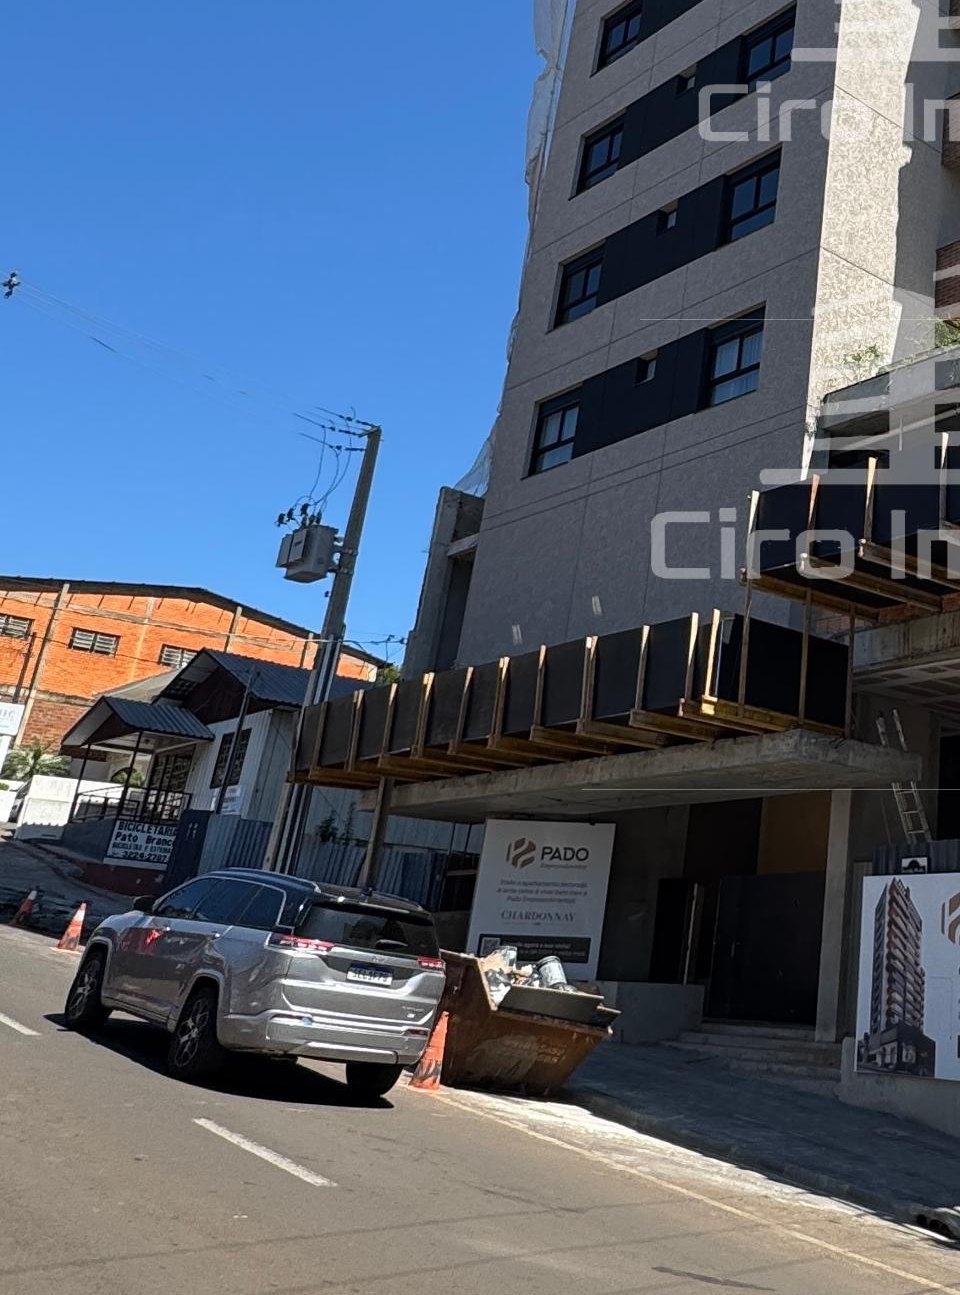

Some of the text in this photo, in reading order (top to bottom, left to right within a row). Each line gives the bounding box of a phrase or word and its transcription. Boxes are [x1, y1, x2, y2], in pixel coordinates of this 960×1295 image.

[115, 831, 173, 846] Pato Branc
[541, 846, 589, 862] PADO
[501, 910, 574, 922] CHARDONNAY
